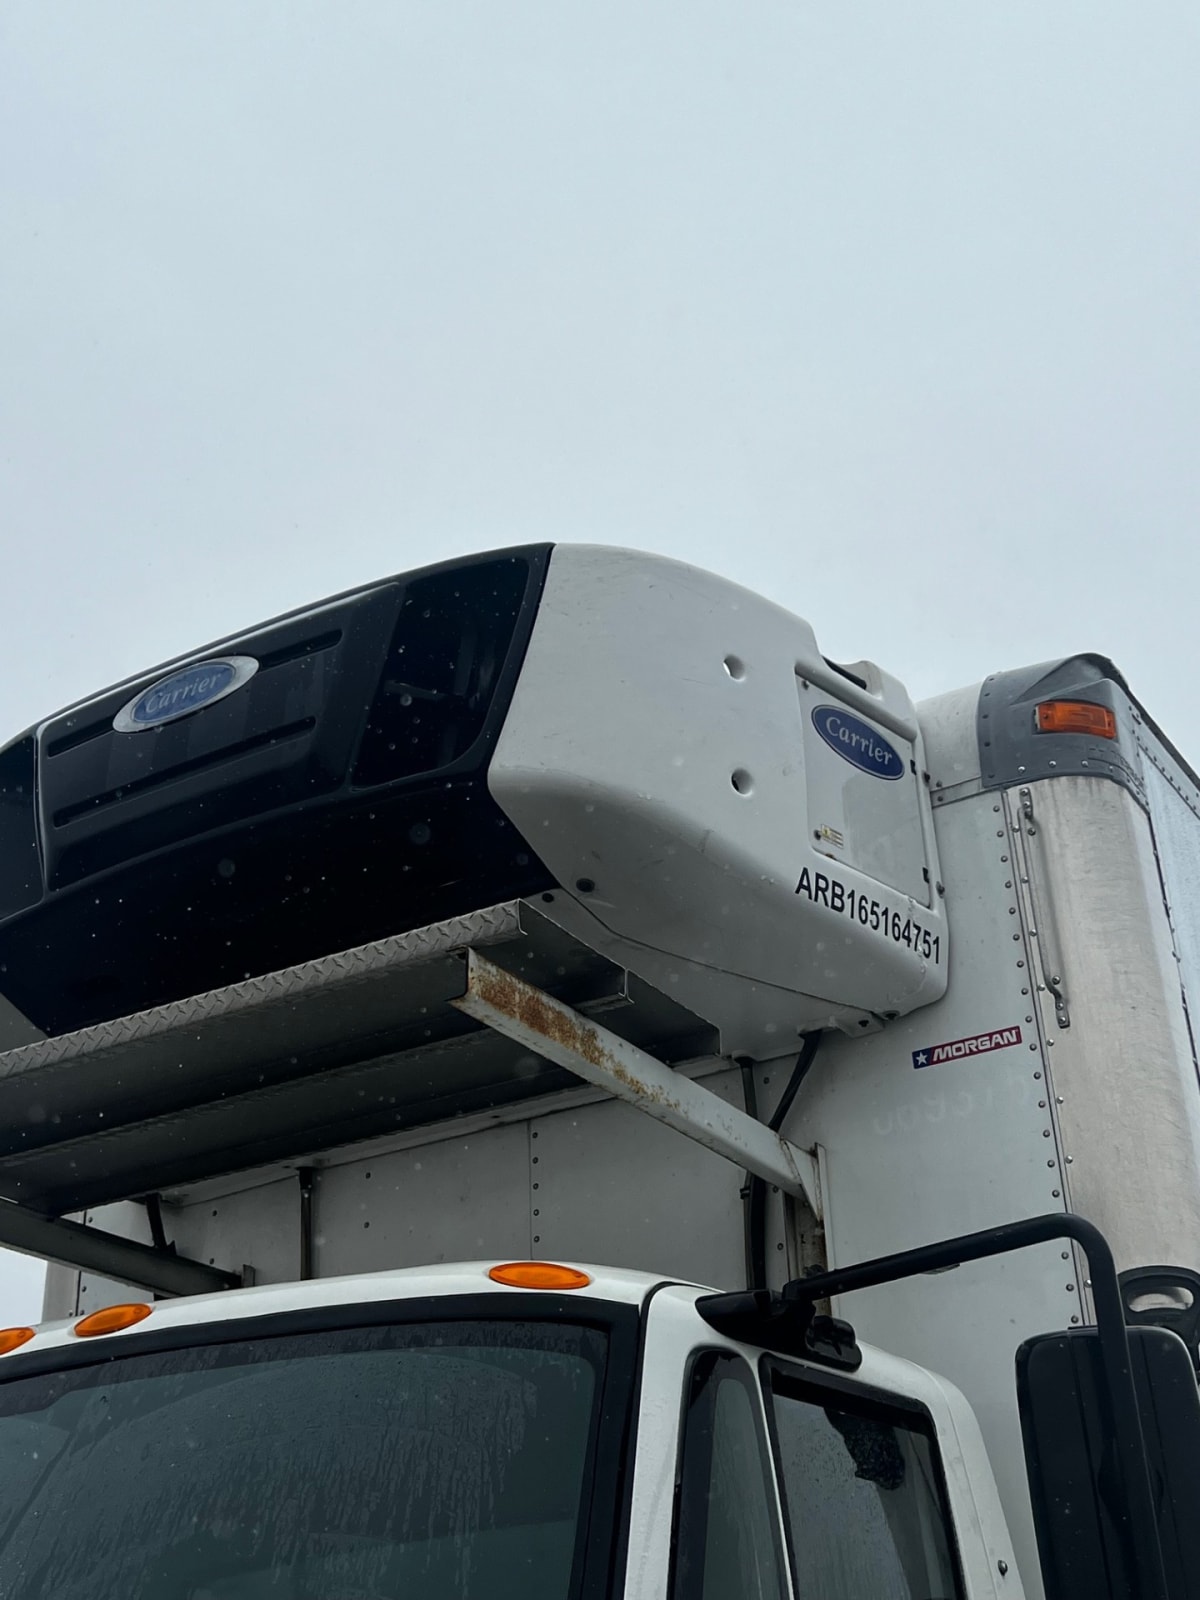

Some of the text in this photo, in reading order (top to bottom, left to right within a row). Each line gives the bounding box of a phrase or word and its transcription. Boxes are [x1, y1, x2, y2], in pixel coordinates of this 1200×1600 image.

[145, 674, 221, 713] Carrier
[826, 717, 892, 765] Carrier
[795, 867, 940, 964] ARB165164751
[933, 1029, 1018, 1062] MORGAN
